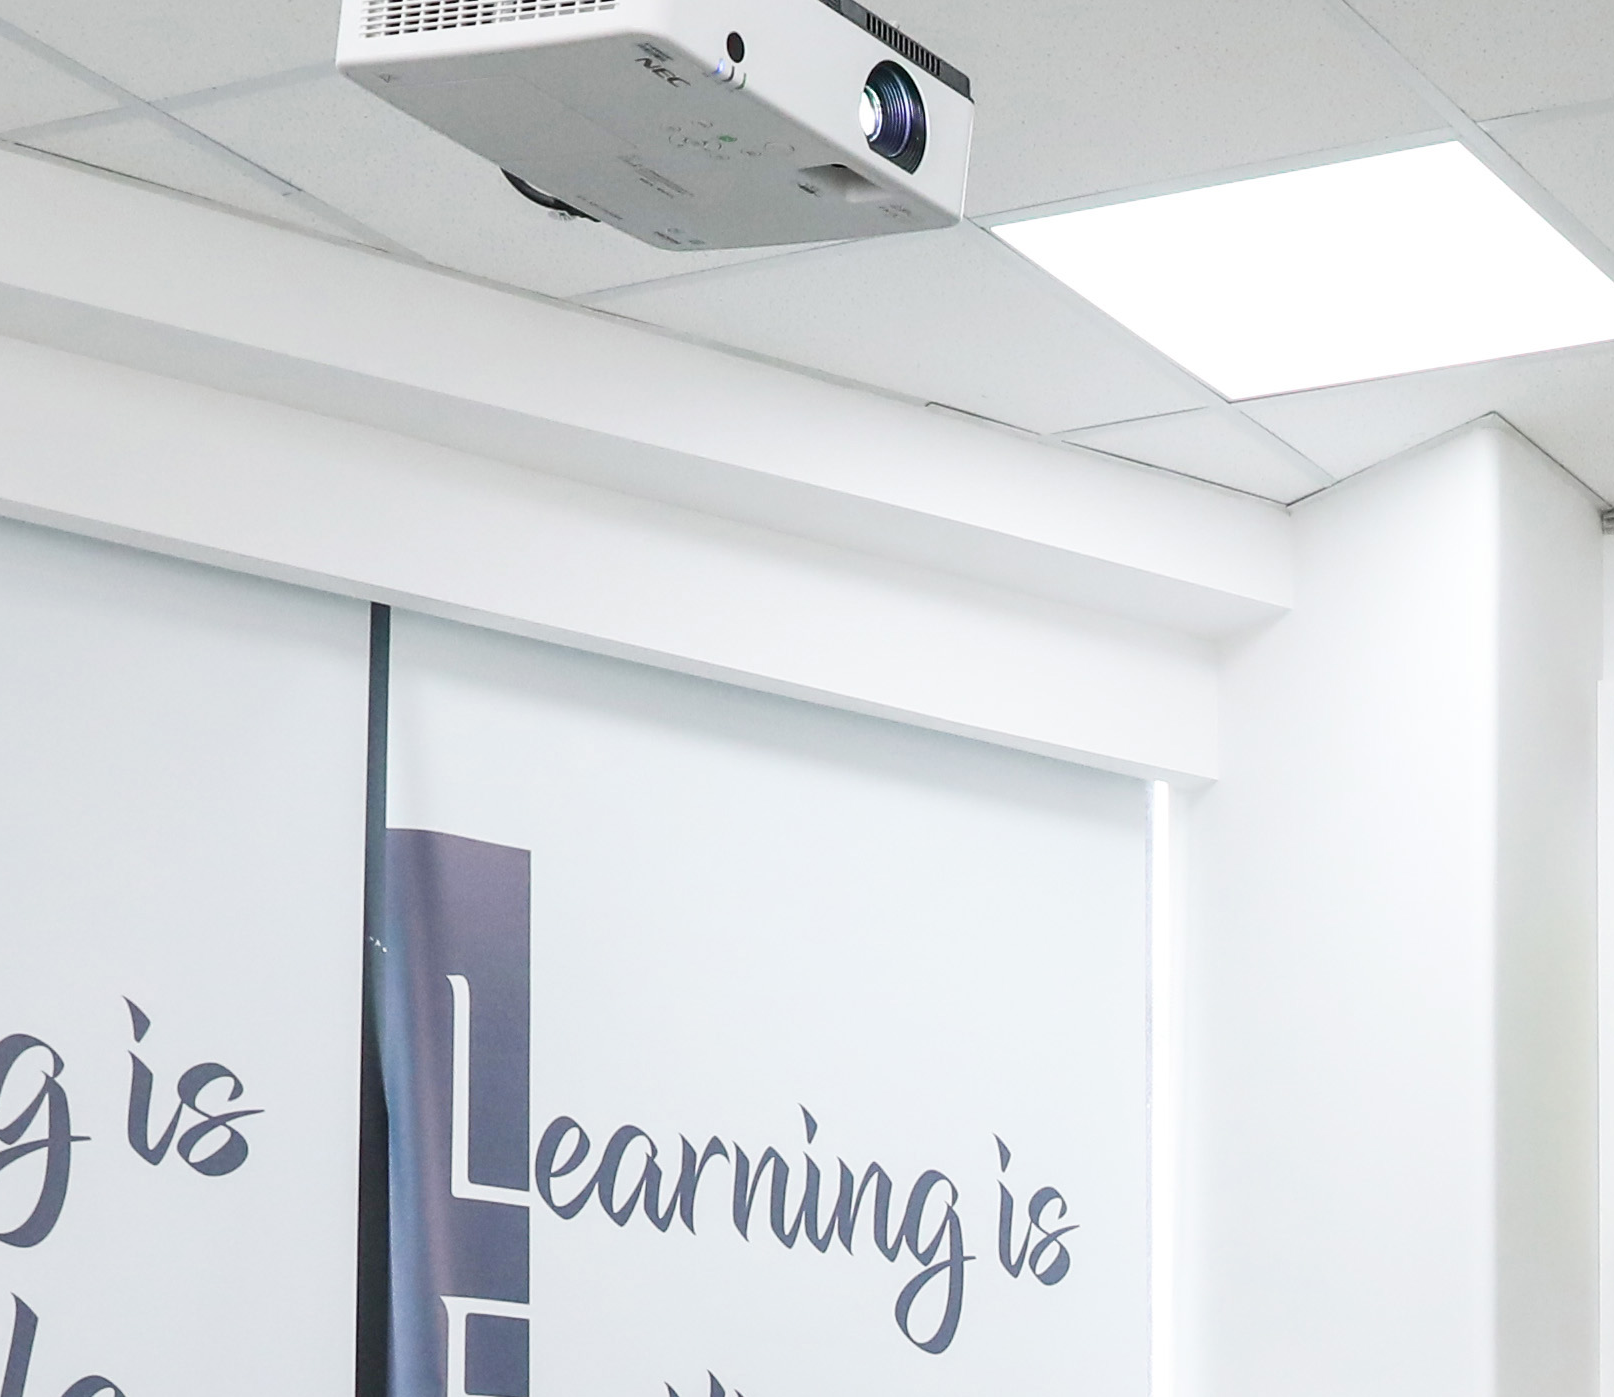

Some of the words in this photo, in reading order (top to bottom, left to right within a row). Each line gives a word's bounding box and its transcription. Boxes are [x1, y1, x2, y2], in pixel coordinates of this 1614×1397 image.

[635, 57, 691, 88] NEC
[123, 996, 265, 1177] is
[446, 973, 976, 1355] Learning
[992, 1132, 1080, 1286] is
